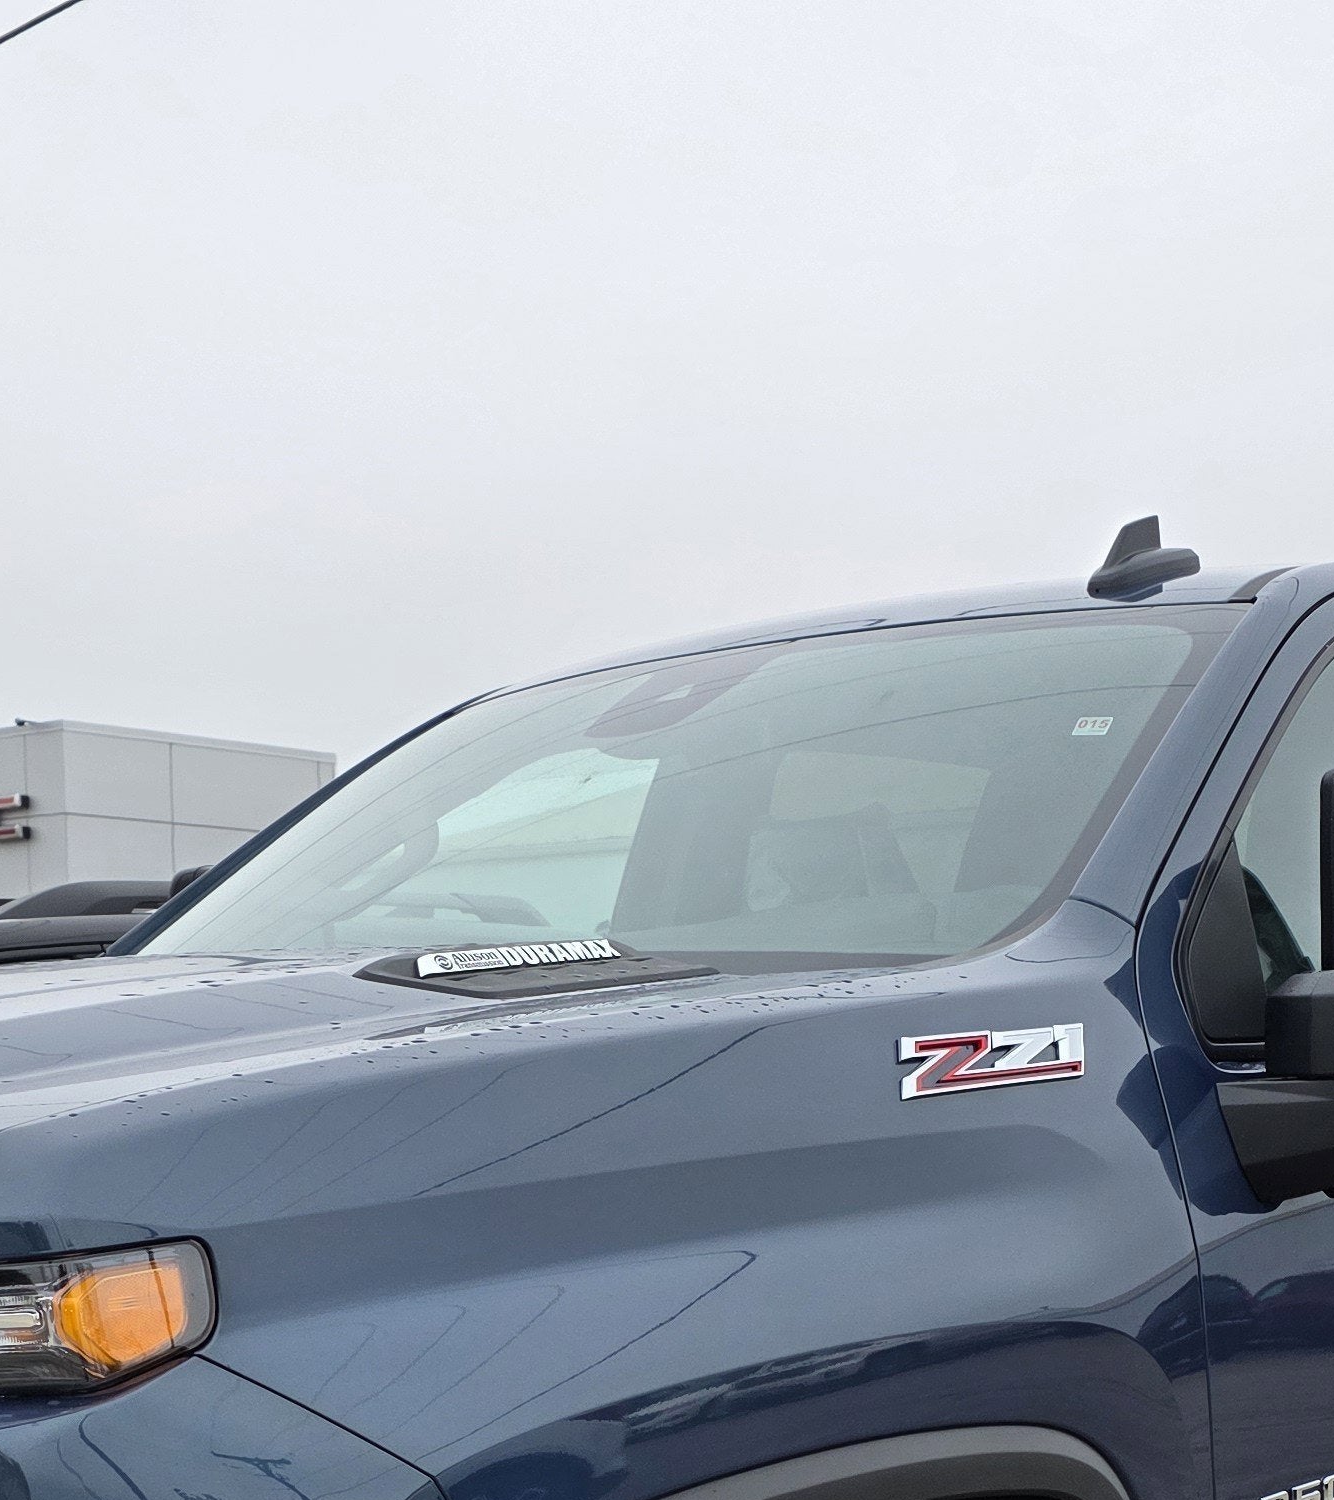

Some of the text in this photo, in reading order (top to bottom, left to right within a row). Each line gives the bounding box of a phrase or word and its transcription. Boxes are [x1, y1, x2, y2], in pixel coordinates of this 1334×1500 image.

[1078, 719, 1108, 729] 015
[452, 950, 499, 963] Allison
[497, 938, 622, 968] DURAMAX
[897, 1022, 1085, 1101] Z71
